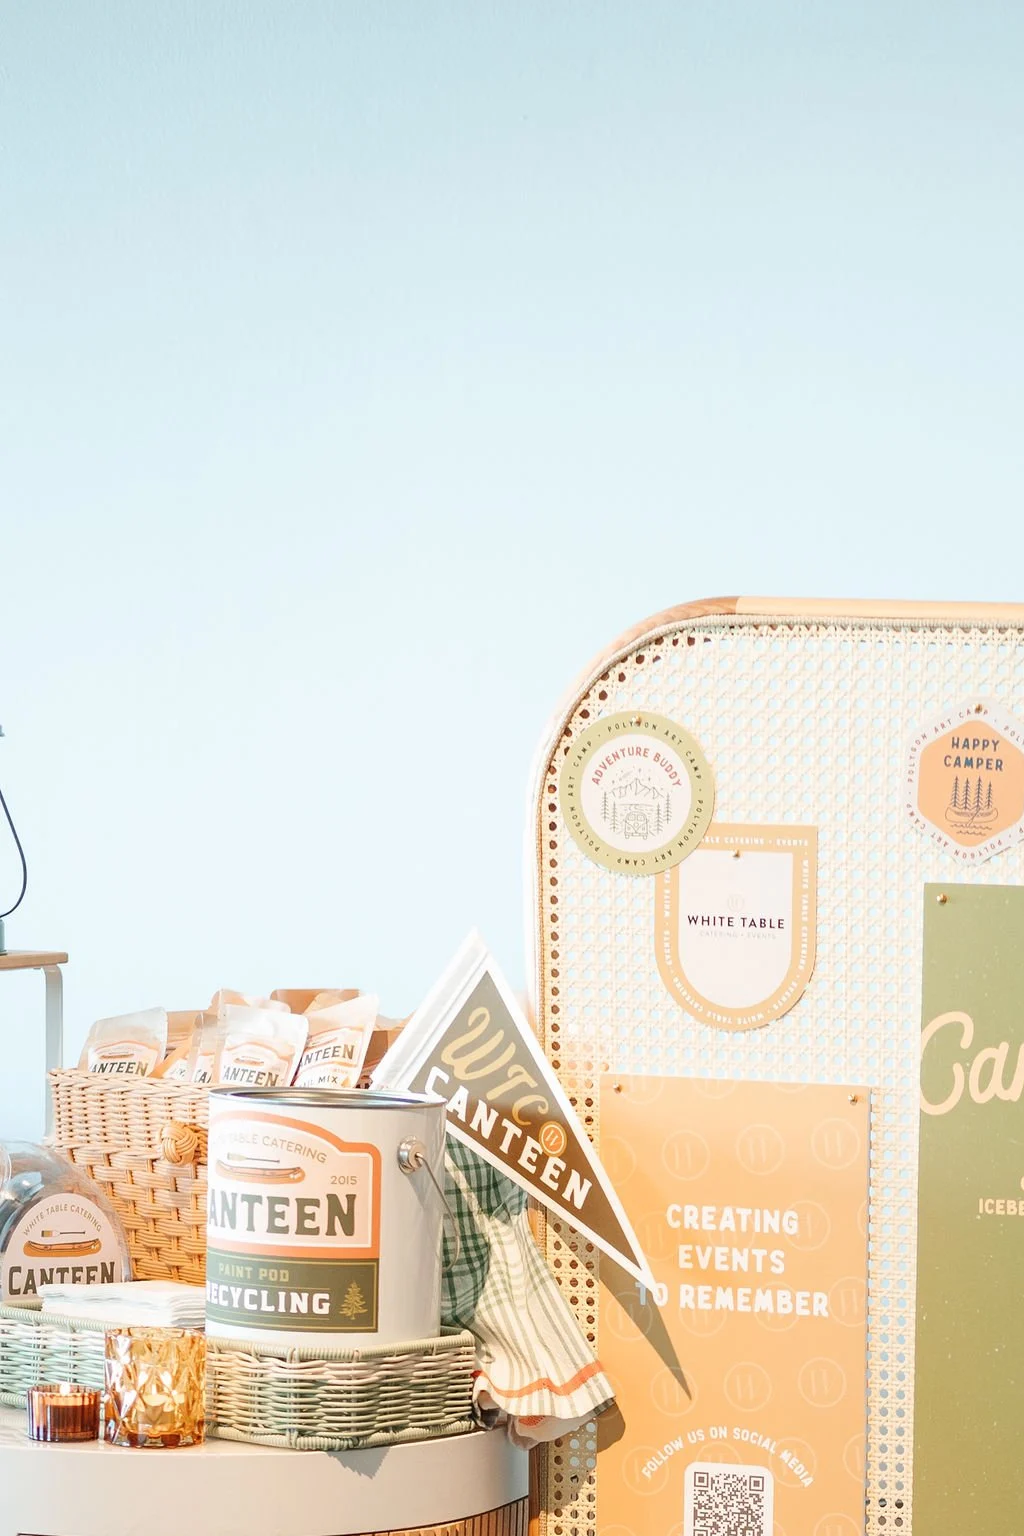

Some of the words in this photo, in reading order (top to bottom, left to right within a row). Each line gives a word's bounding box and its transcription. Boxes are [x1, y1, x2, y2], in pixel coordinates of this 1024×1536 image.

[934, 719, 952, 734] ART
[959, 709, 988, 718] CAP
[574, 741, 593, 767] CAMP
[607, 721, 657, 732] POLYON
[664, 730, 682, 745] ART
[686, 751, 702, 779] CAMP
[951, 736, 1000, 752] HAPPY
[592, 747, 649, 785] ADVENTURE
[653, 752, 682, 787] BUDDY
[943, 755, 1004, 772] CAMPER
[570, 806, 599, 851] POLYGON
[678, 800, 703, 847] POLYGON
[617, 858, 645, 866] CAMP
[654, 850, 673, 863] ART
[954, 839, 1001, 859] POLYGON
[687, 915, 735, 927] WHITE
[740, 917, 785, 929] TABLE
[92, 1060, 149, 1077] ANTEEN
[224, 1067, 279, 1087] ANTEEN
[440, 1006, 549, 1126] WTC
[262, 1135, 328, 1164] CATERING
[424, 1065, 592, 1210] CANTEEN
[330, 1175, 358, 1185] 2015
[23, 1211, 45, 1236] WHITE
[45, 1204, 68, 1216] TABLE
[70, 1204, 102, 1233] CATERING
[208, 1189, 357, 1237] ANTEEN
[665, 1203, 799, 1235] CREATING
[219, 1262, 253, 1280] PAINT
[259, 1267, 290, 1283] POD
[678, 1244, 786, 1275] EVENTS
[635, 1281, 669, 1307] TO
[679, 1283, 830, 1318] REMEMBER
[641, 1436, 684, 1480] FOLLOW
[687, 1429, 705, 1444] US
[709, 1426, 728, 1439] ON
[733, 1427, 777, 1455] SOCIAL
[779, 1449, 814, 1488] MEDIA
